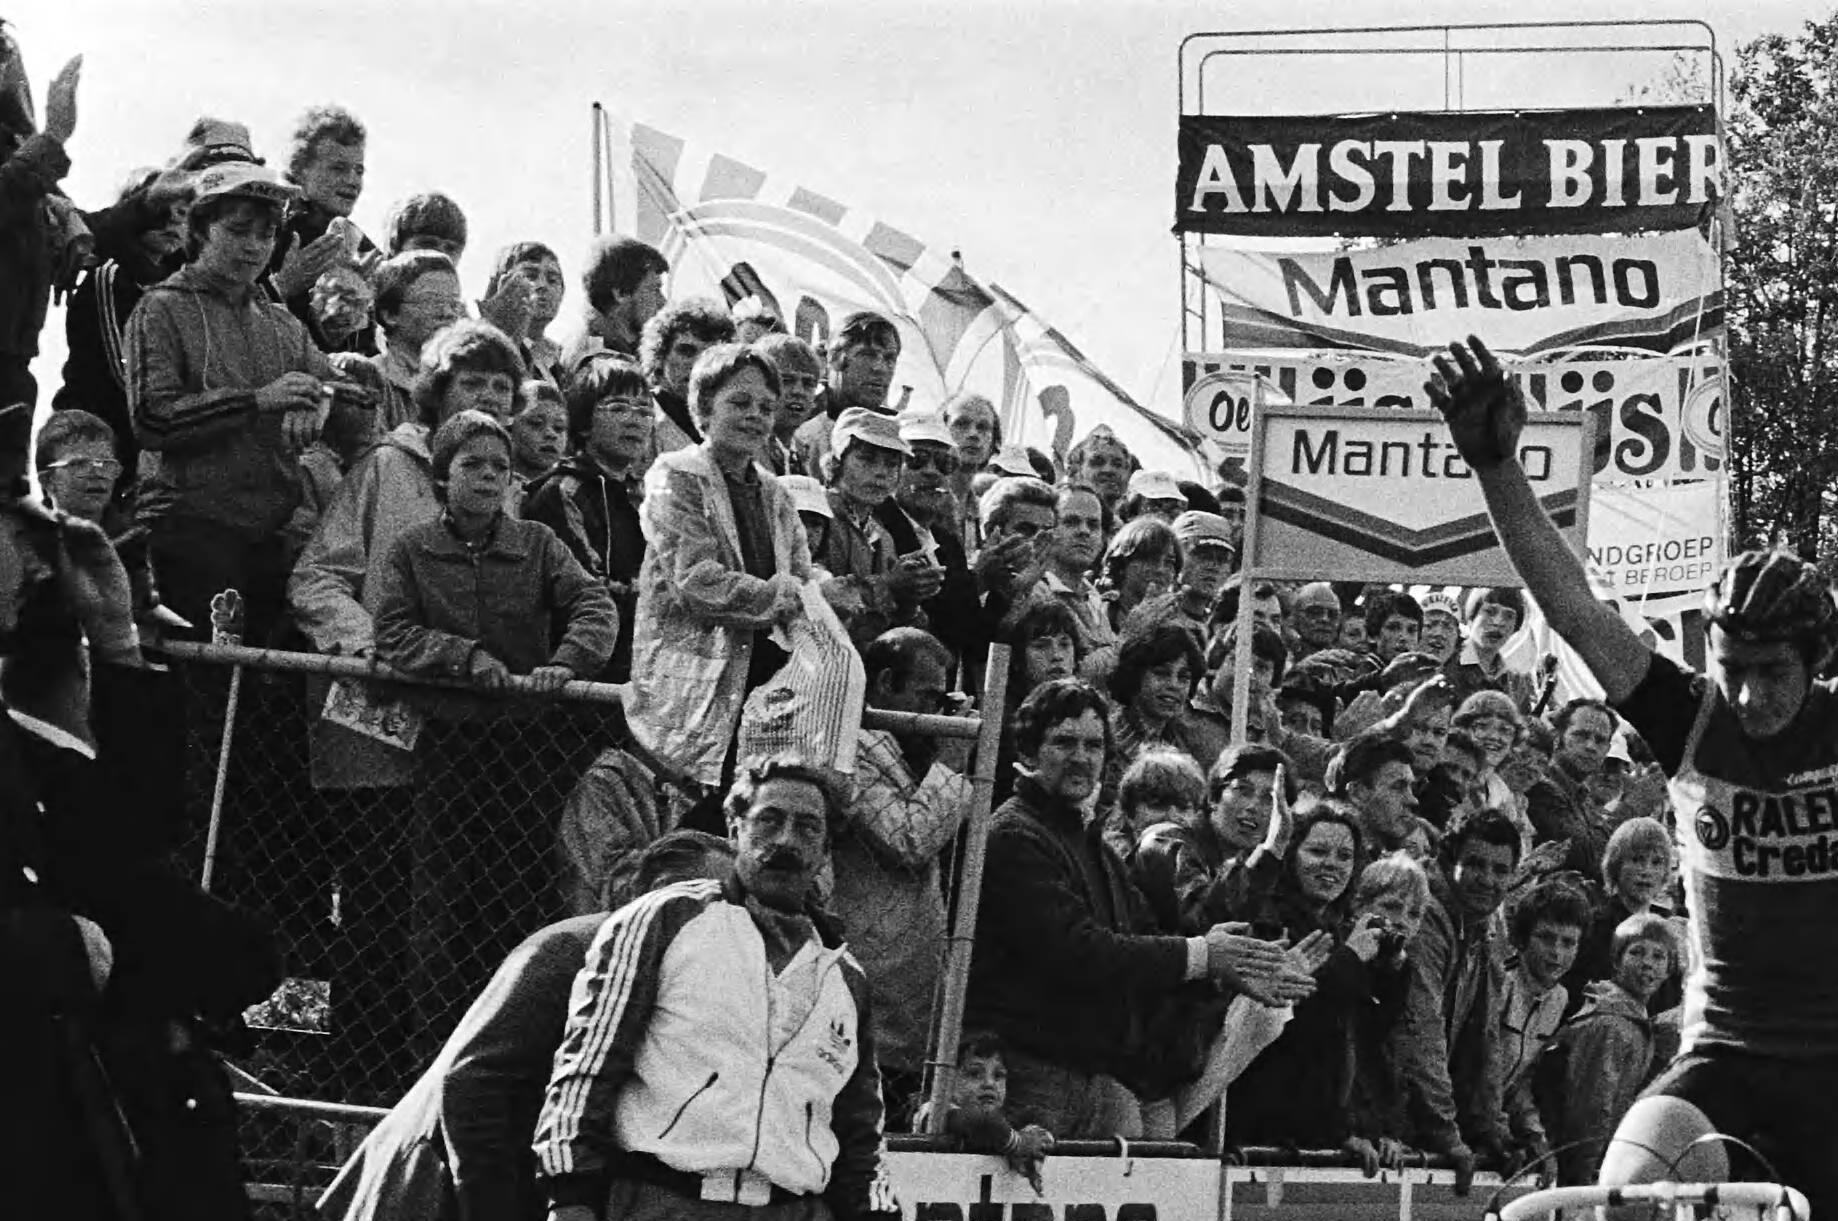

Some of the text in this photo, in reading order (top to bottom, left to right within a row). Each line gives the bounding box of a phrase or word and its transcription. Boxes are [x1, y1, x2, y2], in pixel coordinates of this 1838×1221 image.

[1188, 133, 1723, 213] AMSTEL BIER
[1278, 246, 1661, 317] Mantano
[1209, 390, 1250, 432] Ol
[1291, 428, 1551, 481] Mantao
[1587, 536, 1713, 566] NDGROEP
